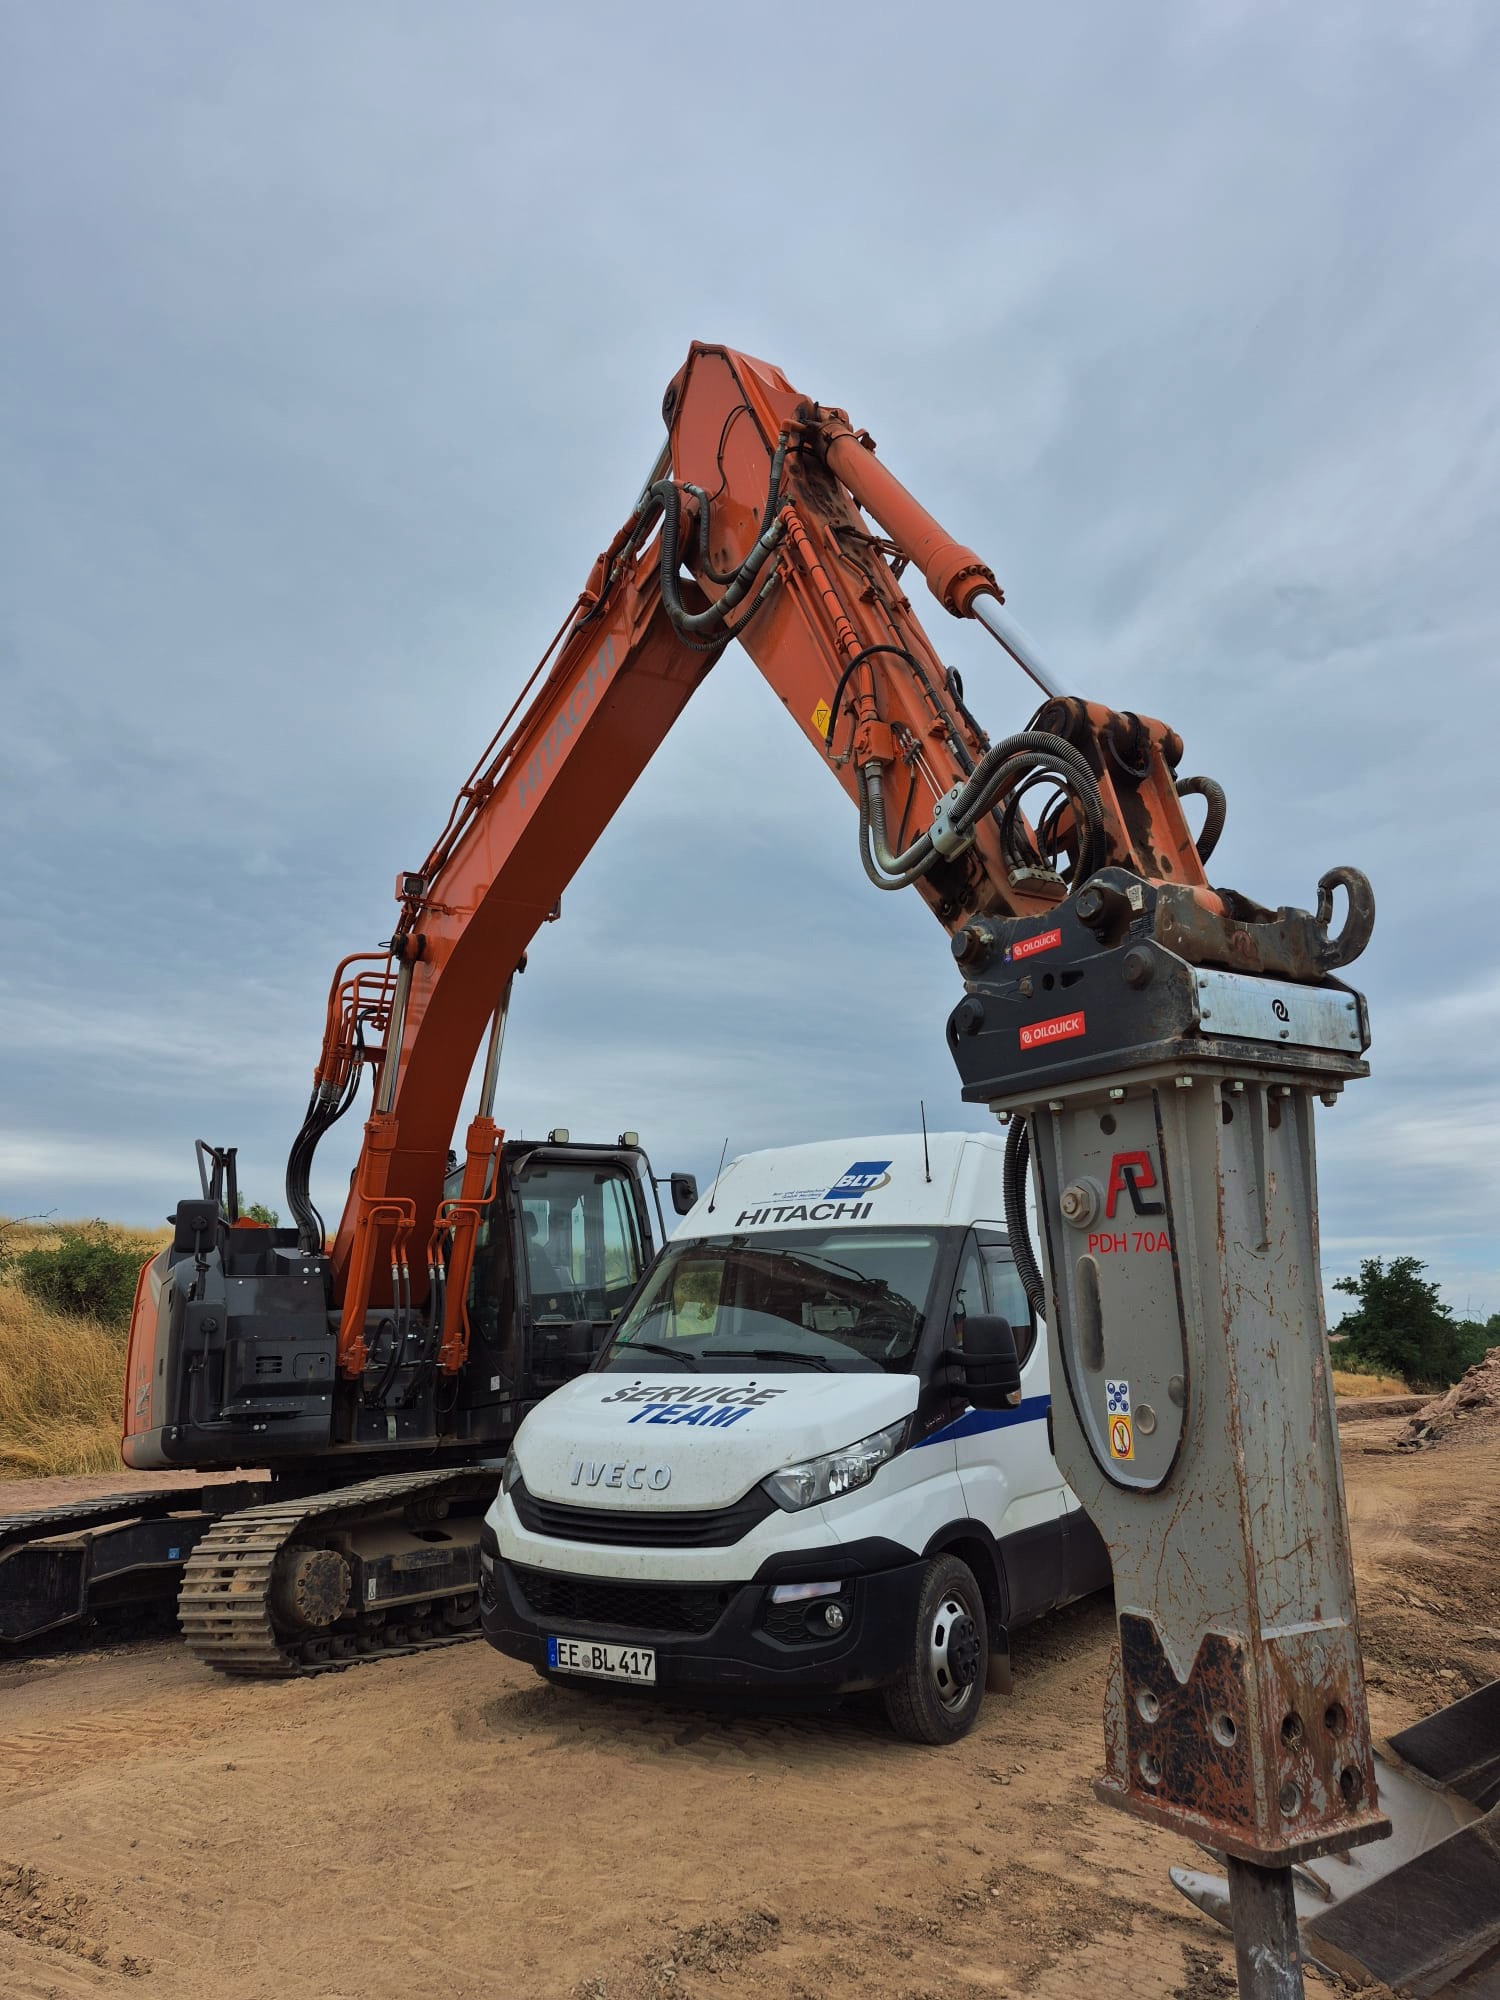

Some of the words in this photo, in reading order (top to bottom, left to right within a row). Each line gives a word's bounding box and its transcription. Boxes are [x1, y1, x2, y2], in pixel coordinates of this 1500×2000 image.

[518, 632, 616, 810] HITACHI
[1022, 934, 1057, 953] OILQUICK
[1033, 1018, 1080, 1040] OILQUICK
[735, 1202, 873, 1227] HITACHI
[1087, 1232, 1128, 1254] PDH
[1131, 1231, 1172, 1253] 70A
[601, 1386, 788, 1406] SERVICE
[627, 1403, 755, 1427] TEAM
[569, 1459, 672, 1491] IVECO
[558, 1642, 580, 1667] EE
[591, 1646, 615, 1672] BL
[618, 1650, 653, 1676] 417
